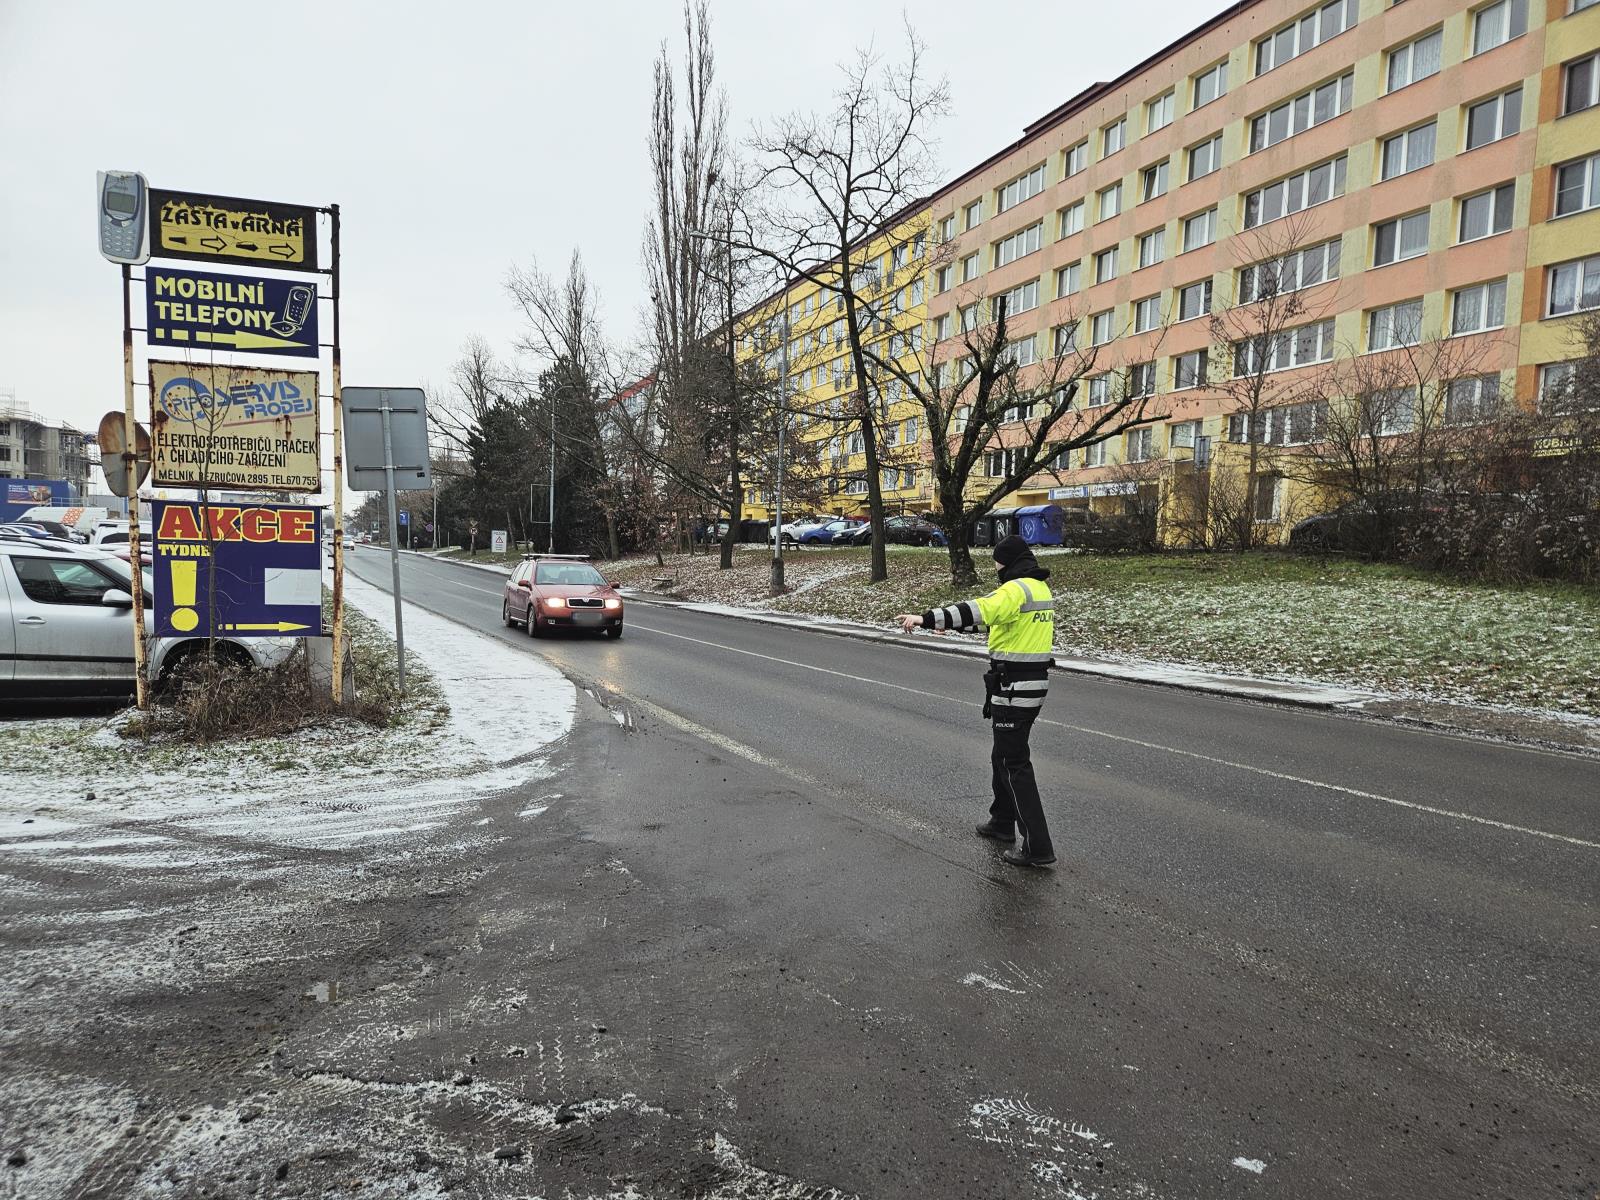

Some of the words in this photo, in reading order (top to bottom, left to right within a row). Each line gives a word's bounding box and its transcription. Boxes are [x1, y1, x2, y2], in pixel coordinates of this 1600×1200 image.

[155, 275, 264, 305] MOBILNÍ
[154, 300, 275, 331] TELEFONY
[214, 380, 301, 407] SERVIS
[243, 399, 312, 418] PRODEJ
[157, 448, 165, 461] A
[237, 451, 287, 467] ZAŘÍZENÍ
[275, 438, 316, 454] PRAČEK
[158, 469, 194, 480] MĚLNÍK
[301, 476, 317, 486] 755
[157, 505, 315, 543] AKCE
